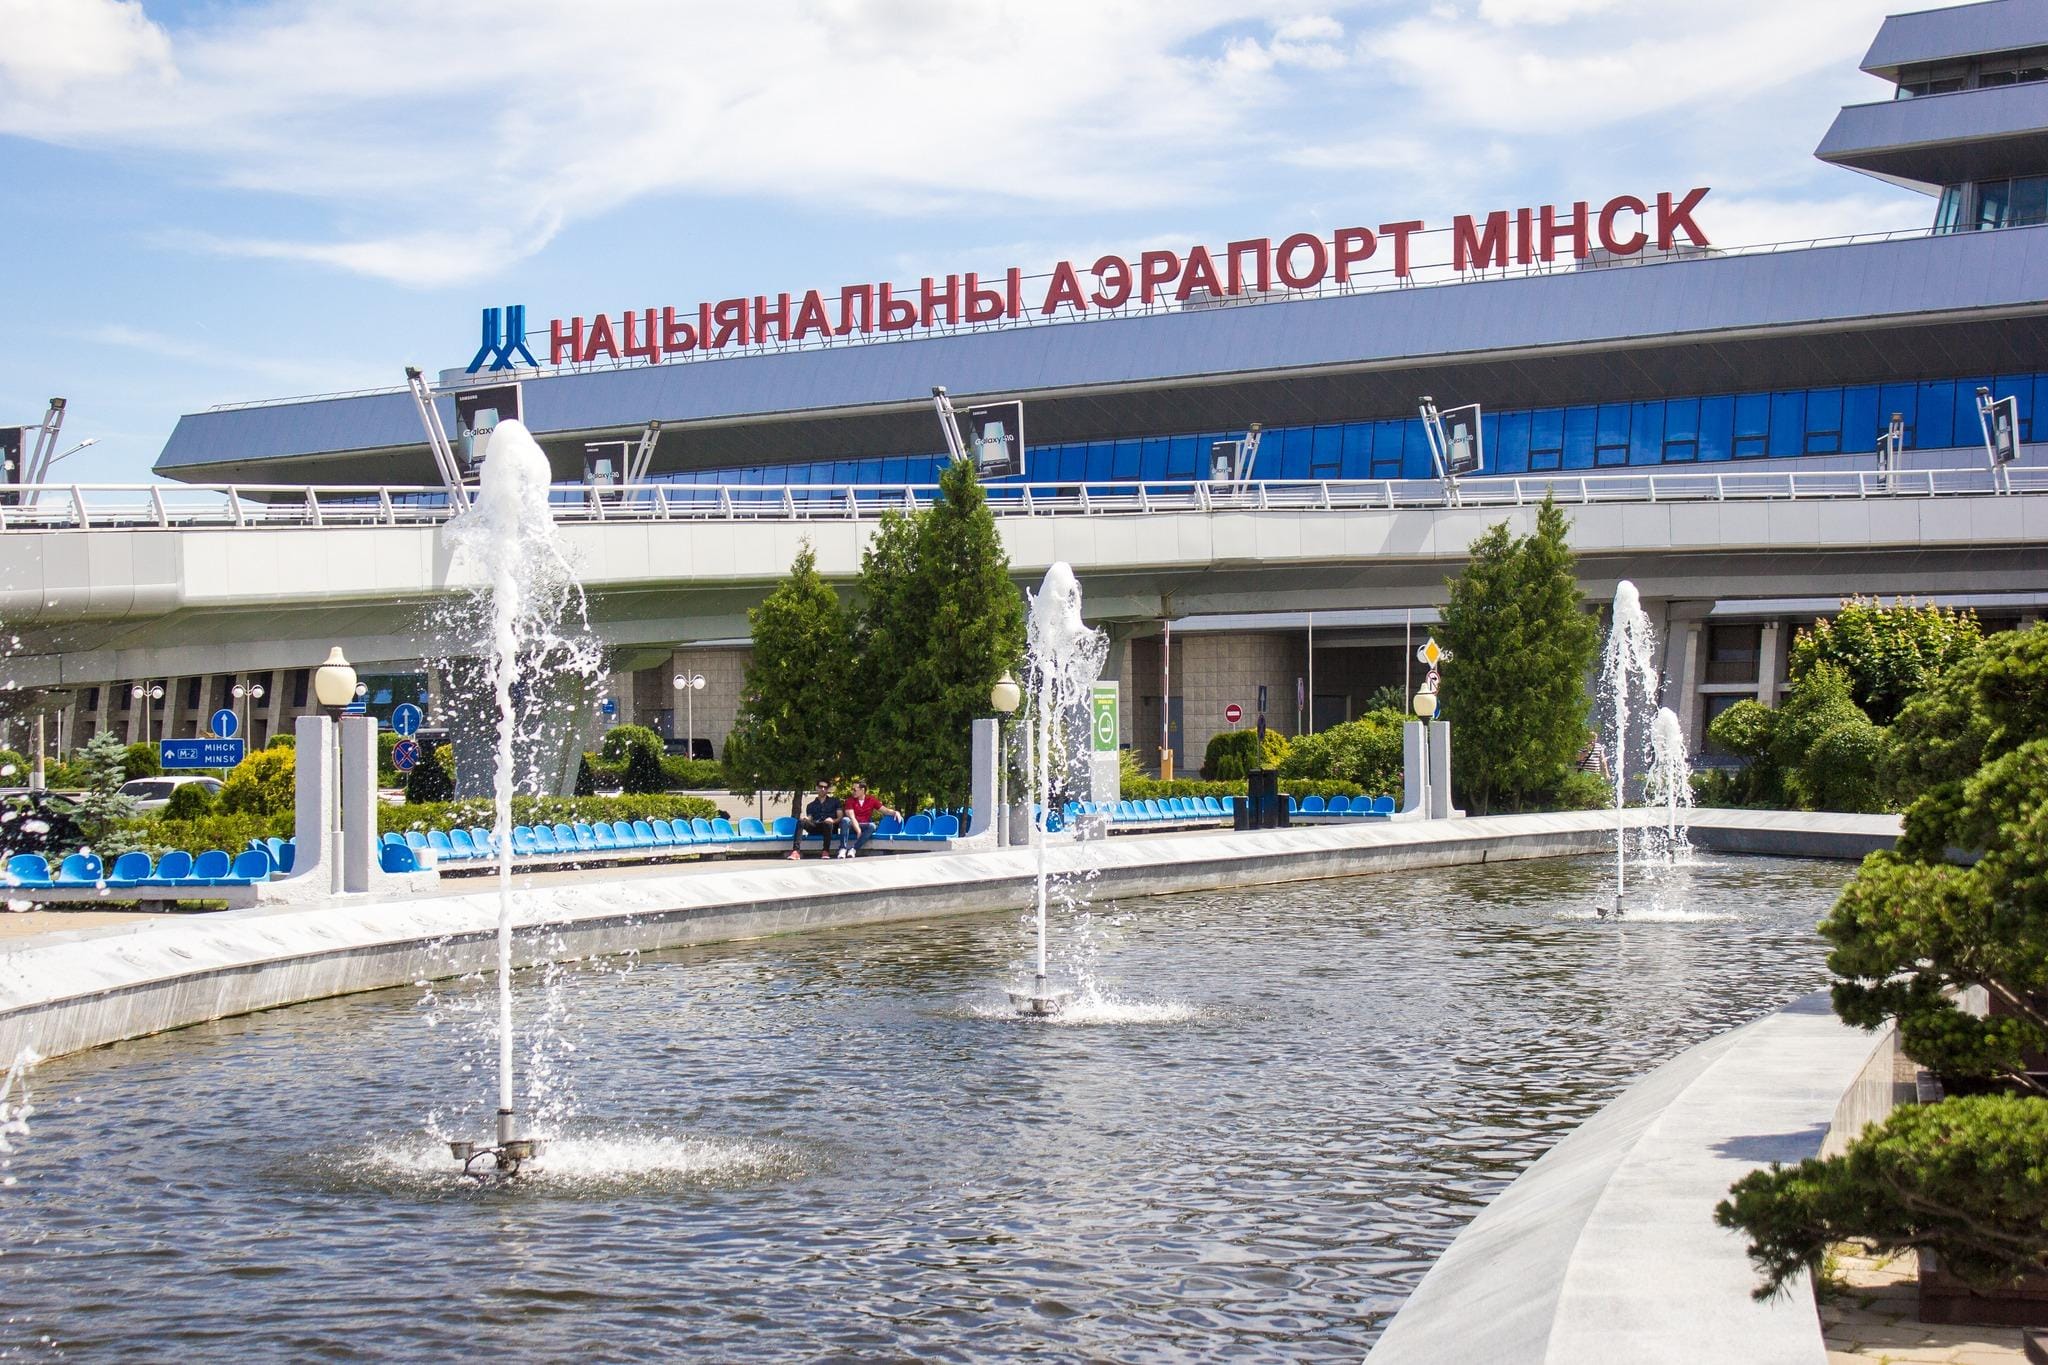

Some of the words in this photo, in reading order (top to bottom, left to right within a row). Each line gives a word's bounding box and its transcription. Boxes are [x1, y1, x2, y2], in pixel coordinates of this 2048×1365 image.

[551, 267, 1021, 365] НАЦЫЯНАЛЬНЫ
[1042, 221, 1425, 314] АЭРАПОРТ
[1453, 188, 1711, 271] МІНСК
[204, 743, 235, 752] МІНСК
[204, 755, 236, 763] MINSK
